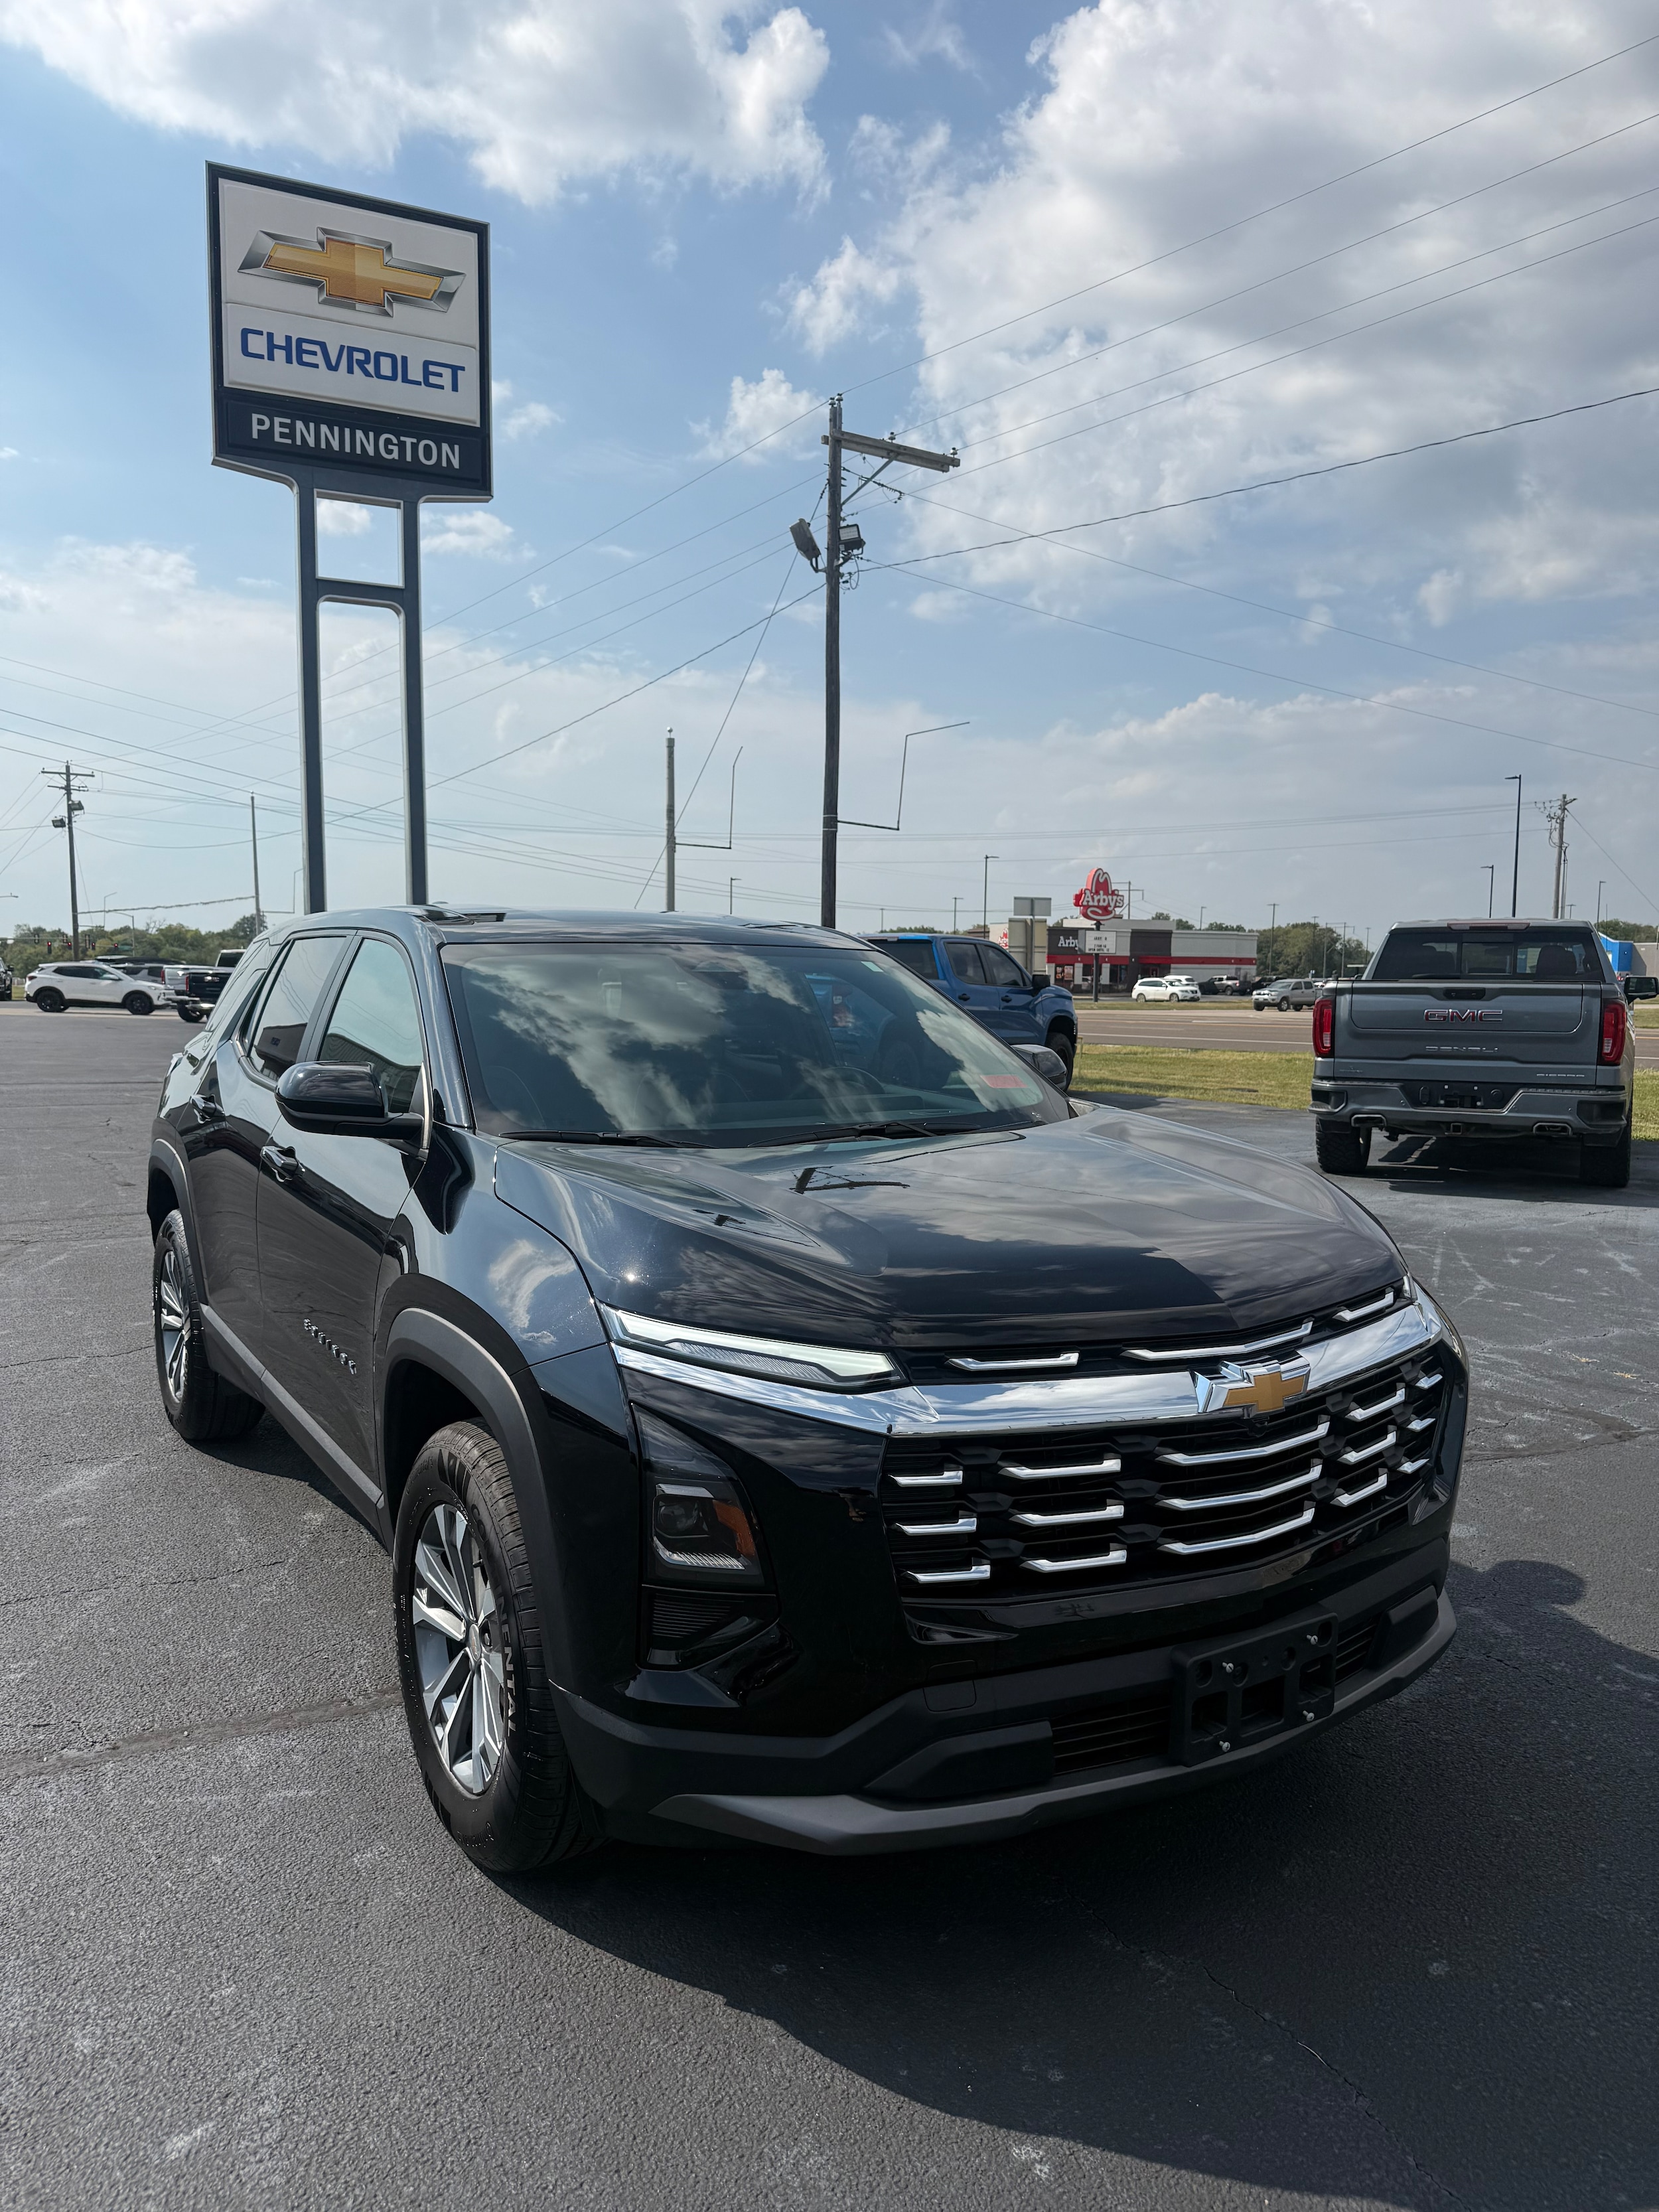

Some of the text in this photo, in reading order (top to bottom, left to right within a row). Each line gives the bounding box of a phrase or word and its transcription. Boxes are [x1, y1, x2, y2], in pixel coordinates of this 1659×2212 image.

[240, 327, 466, 393] CHEVROLET
[251, 413, 461, 469] PENNINGTON
[1082, 889, 1123, 911] Arby's
[1424, 1009, 1503, 1023] GMC
